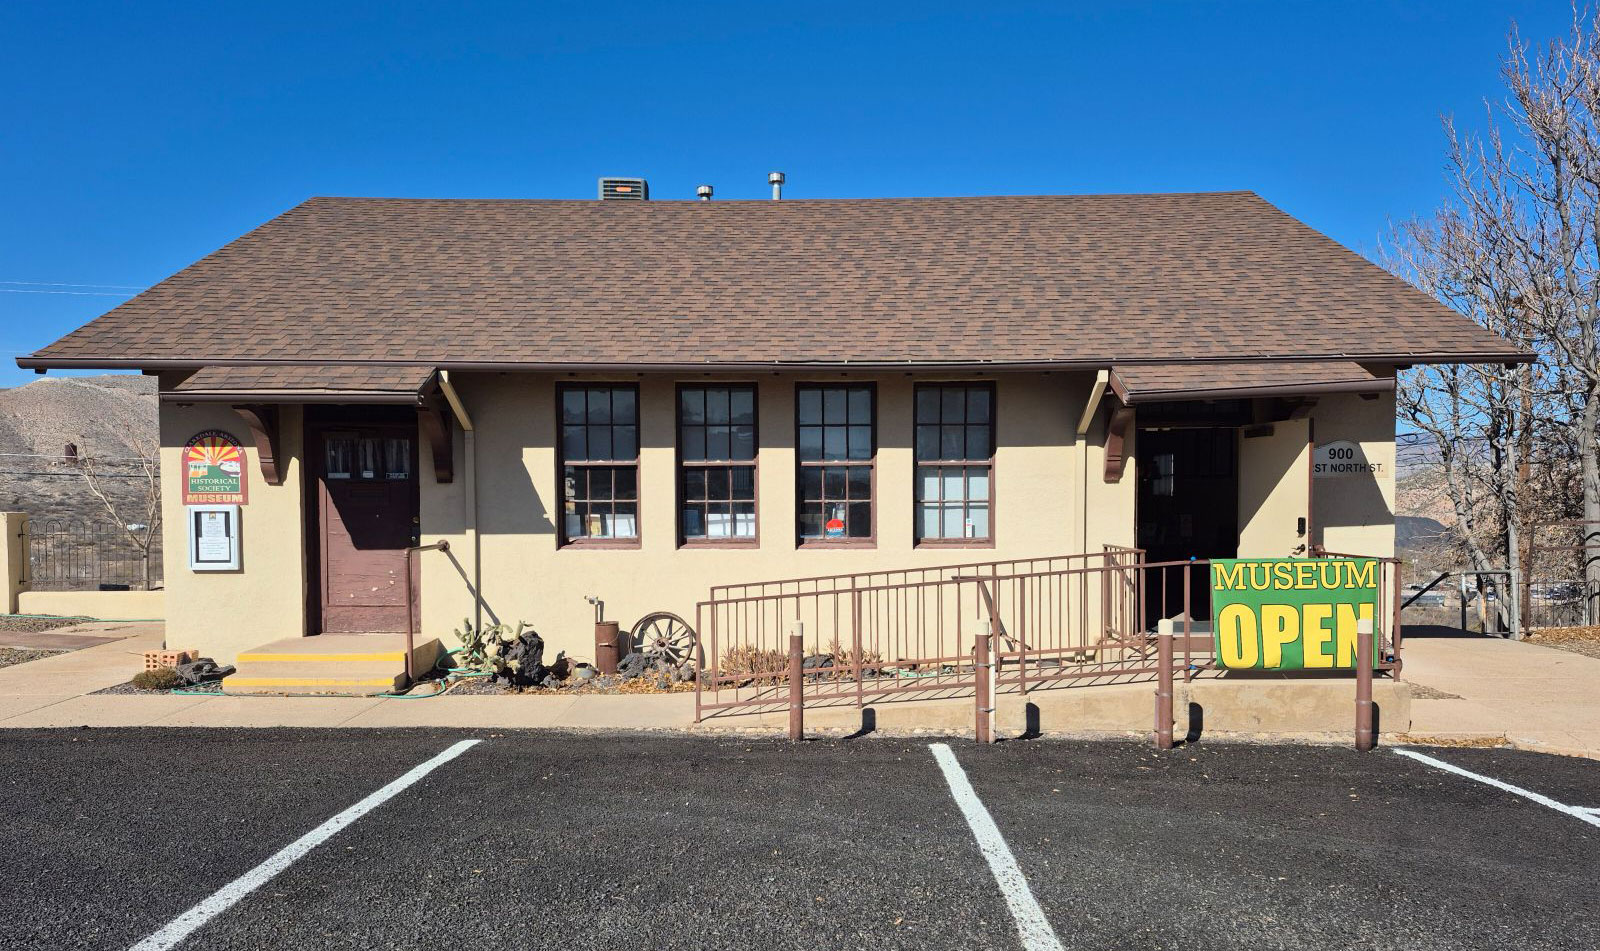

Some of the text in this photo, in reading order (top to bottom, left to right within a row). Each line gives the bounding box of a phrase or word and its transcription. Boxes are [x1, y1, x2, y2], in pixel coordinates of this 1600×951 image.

[1328, 448, 1354, 460] 900
[1312, 463, 1384, 473] ST NORTH ST.
[186, 494, 243, 503] MUSEUM
[1212, 560, 1377, 591] MUSEUM
[1218, 602, 1375, 669] OPEN
